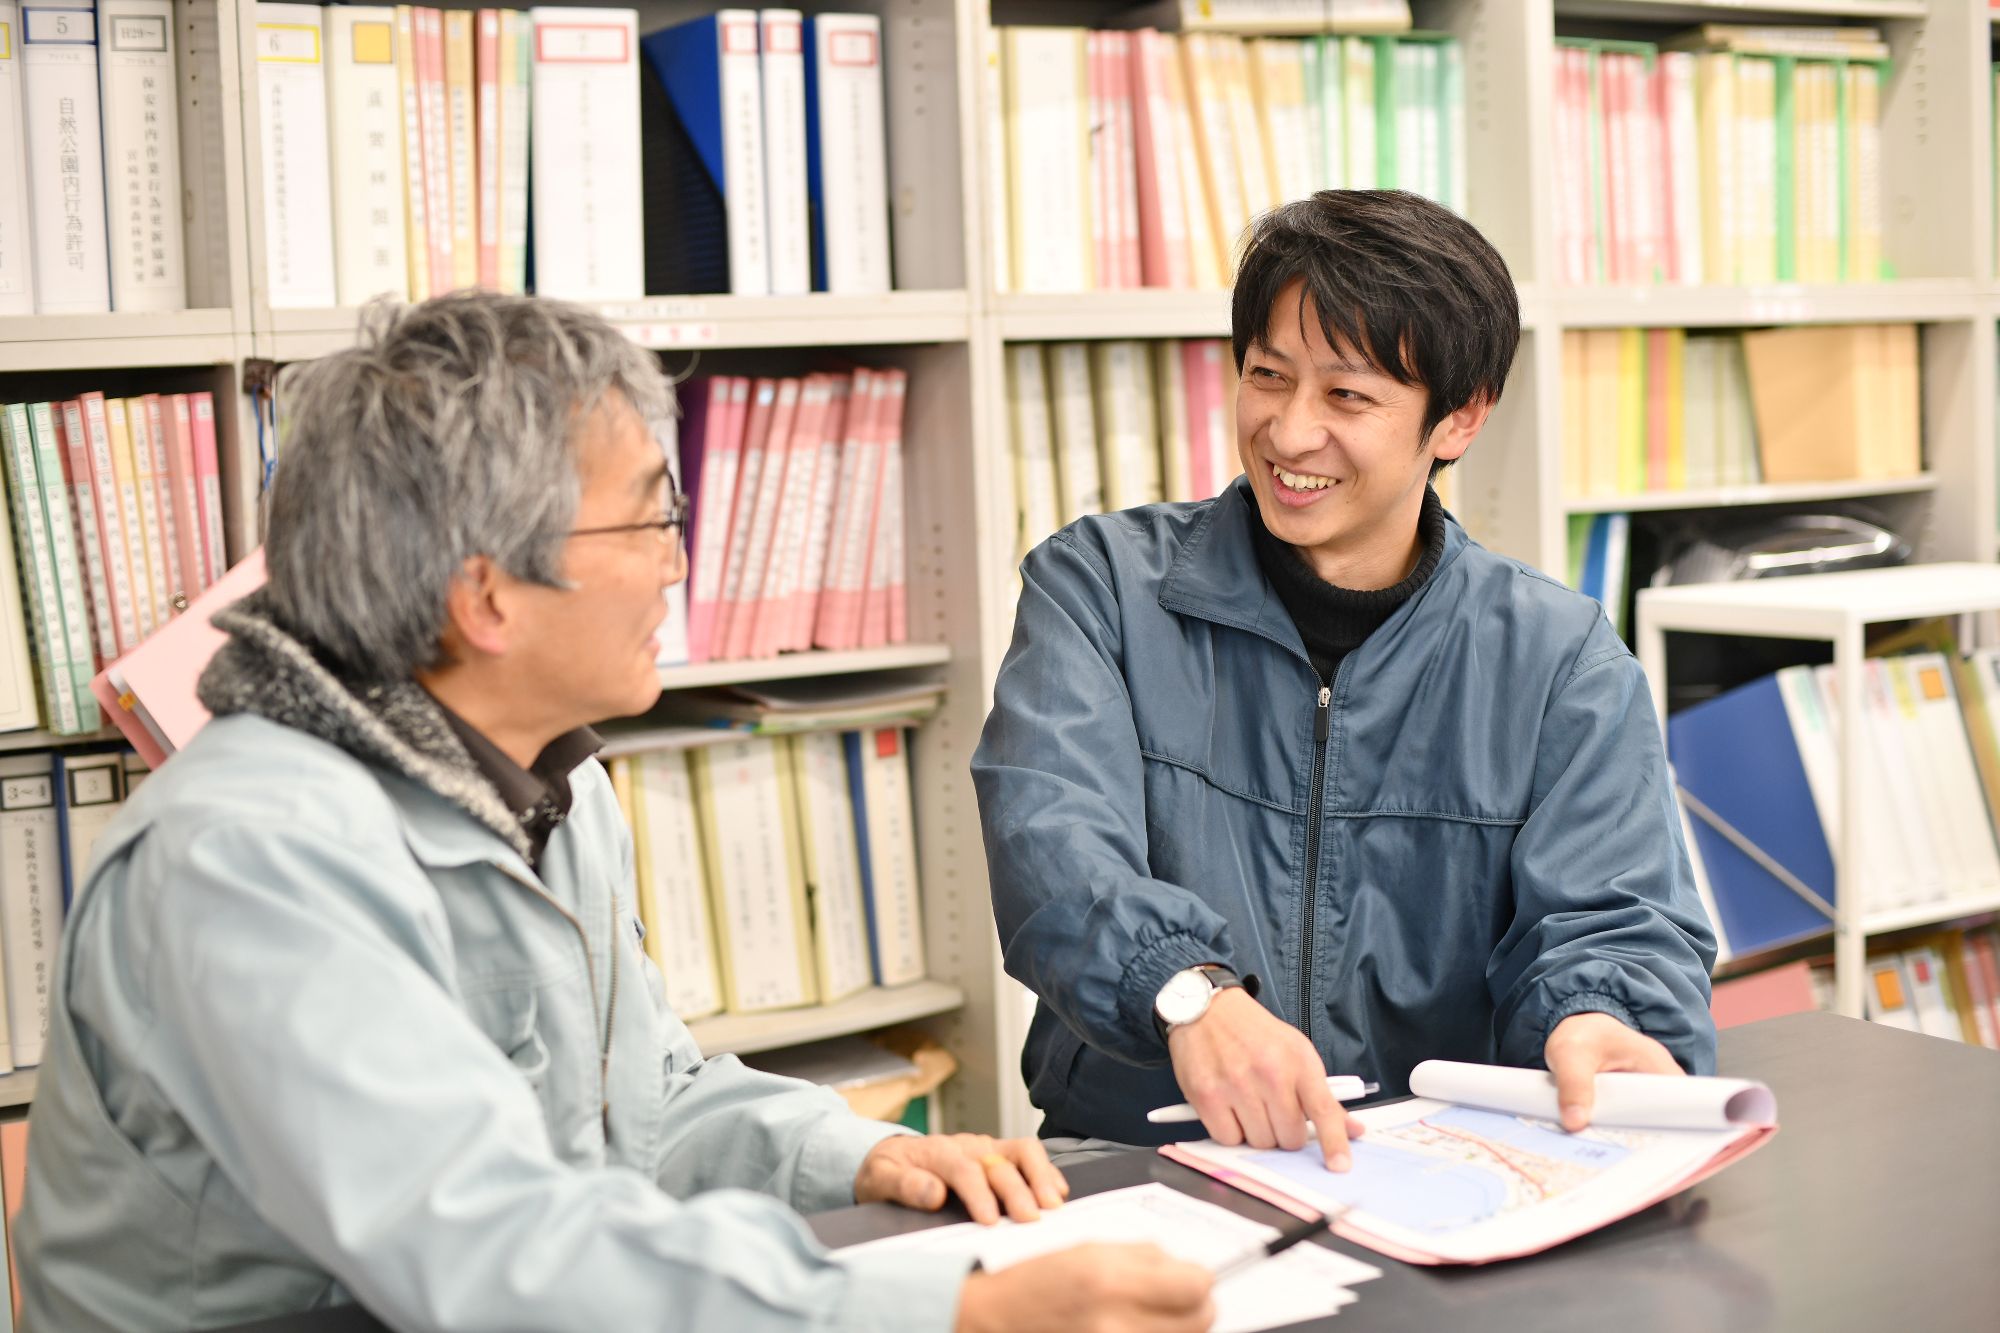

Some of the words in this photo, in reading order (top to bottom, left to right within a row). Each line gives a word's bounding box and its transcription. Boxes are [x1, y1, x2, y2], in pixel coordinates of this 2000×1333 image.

[56, 16, 68, 35] 5
[58, 96, 85, 271] 自然公園内行為許可
